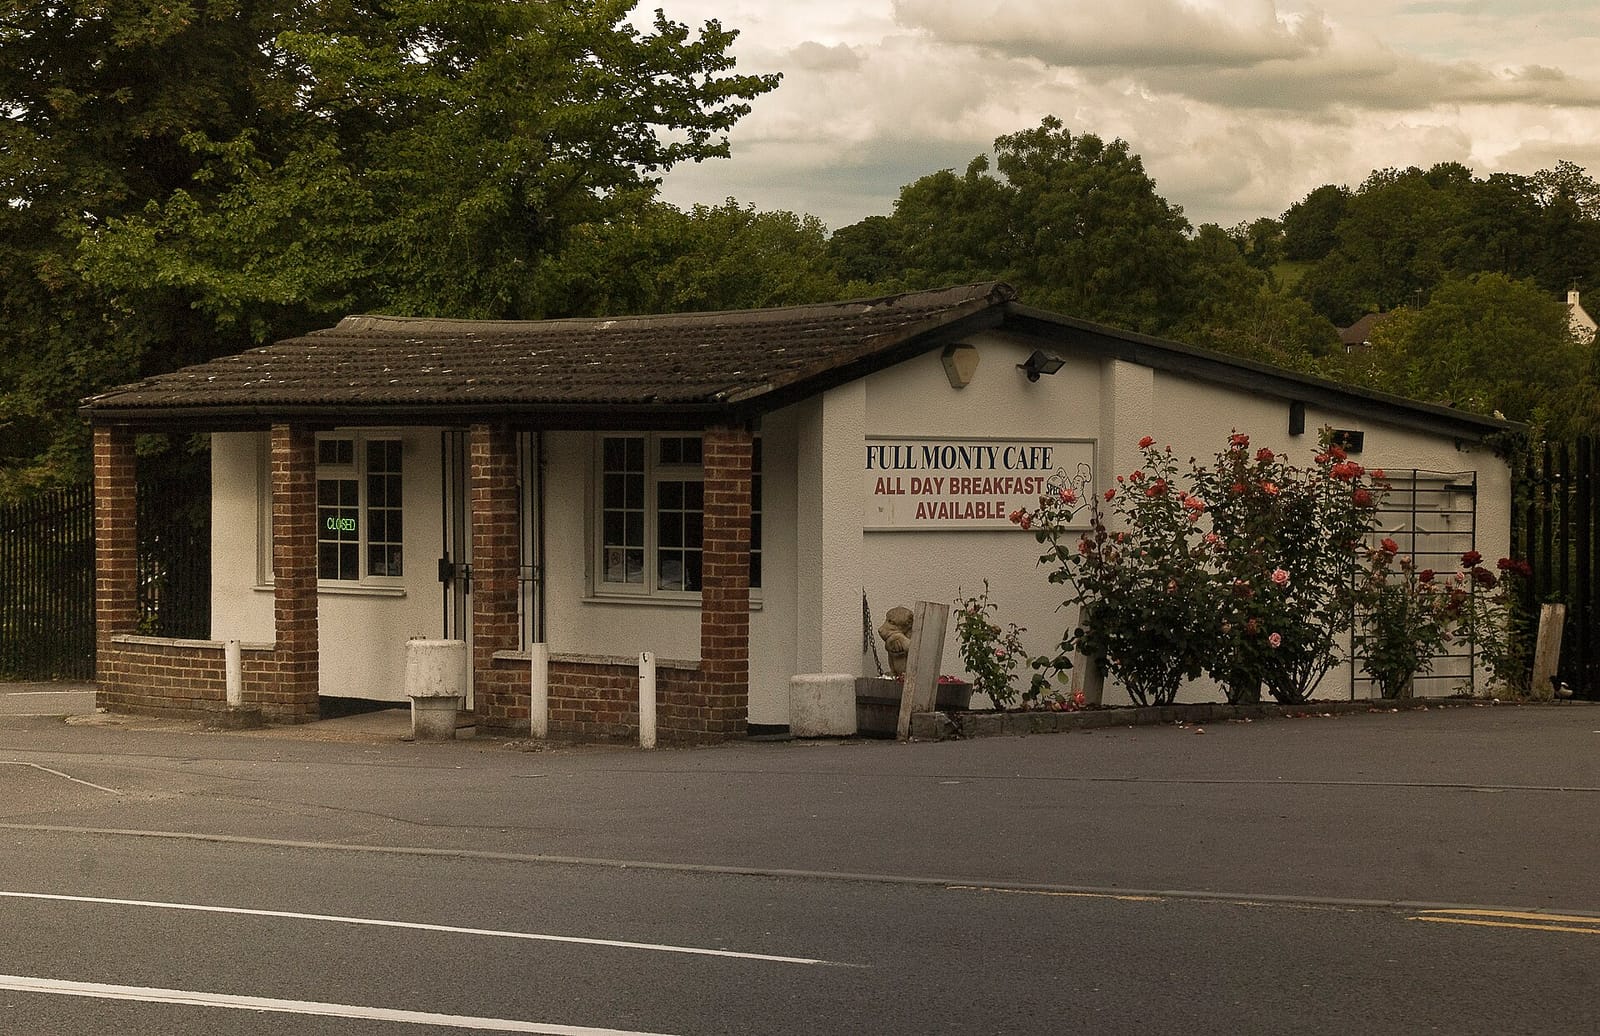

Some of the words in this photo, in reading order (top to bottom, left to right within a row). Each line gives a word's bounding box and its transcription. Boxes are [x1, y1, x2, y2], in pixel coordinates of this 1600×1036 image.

[865, 445, 917, 470] FULL
[921, 445, 1000, 470] MONTY
[1003, 446, 1054, 470] CAFE
[874, 477, 906, 495] ALL
[911, 477, 945, 495] DAY
[949, 476, 1044, 495] BREAKFAST
[915, 501, 1006, 520] AVAILABLE
[326, 517, 356, 531] CLOSED
